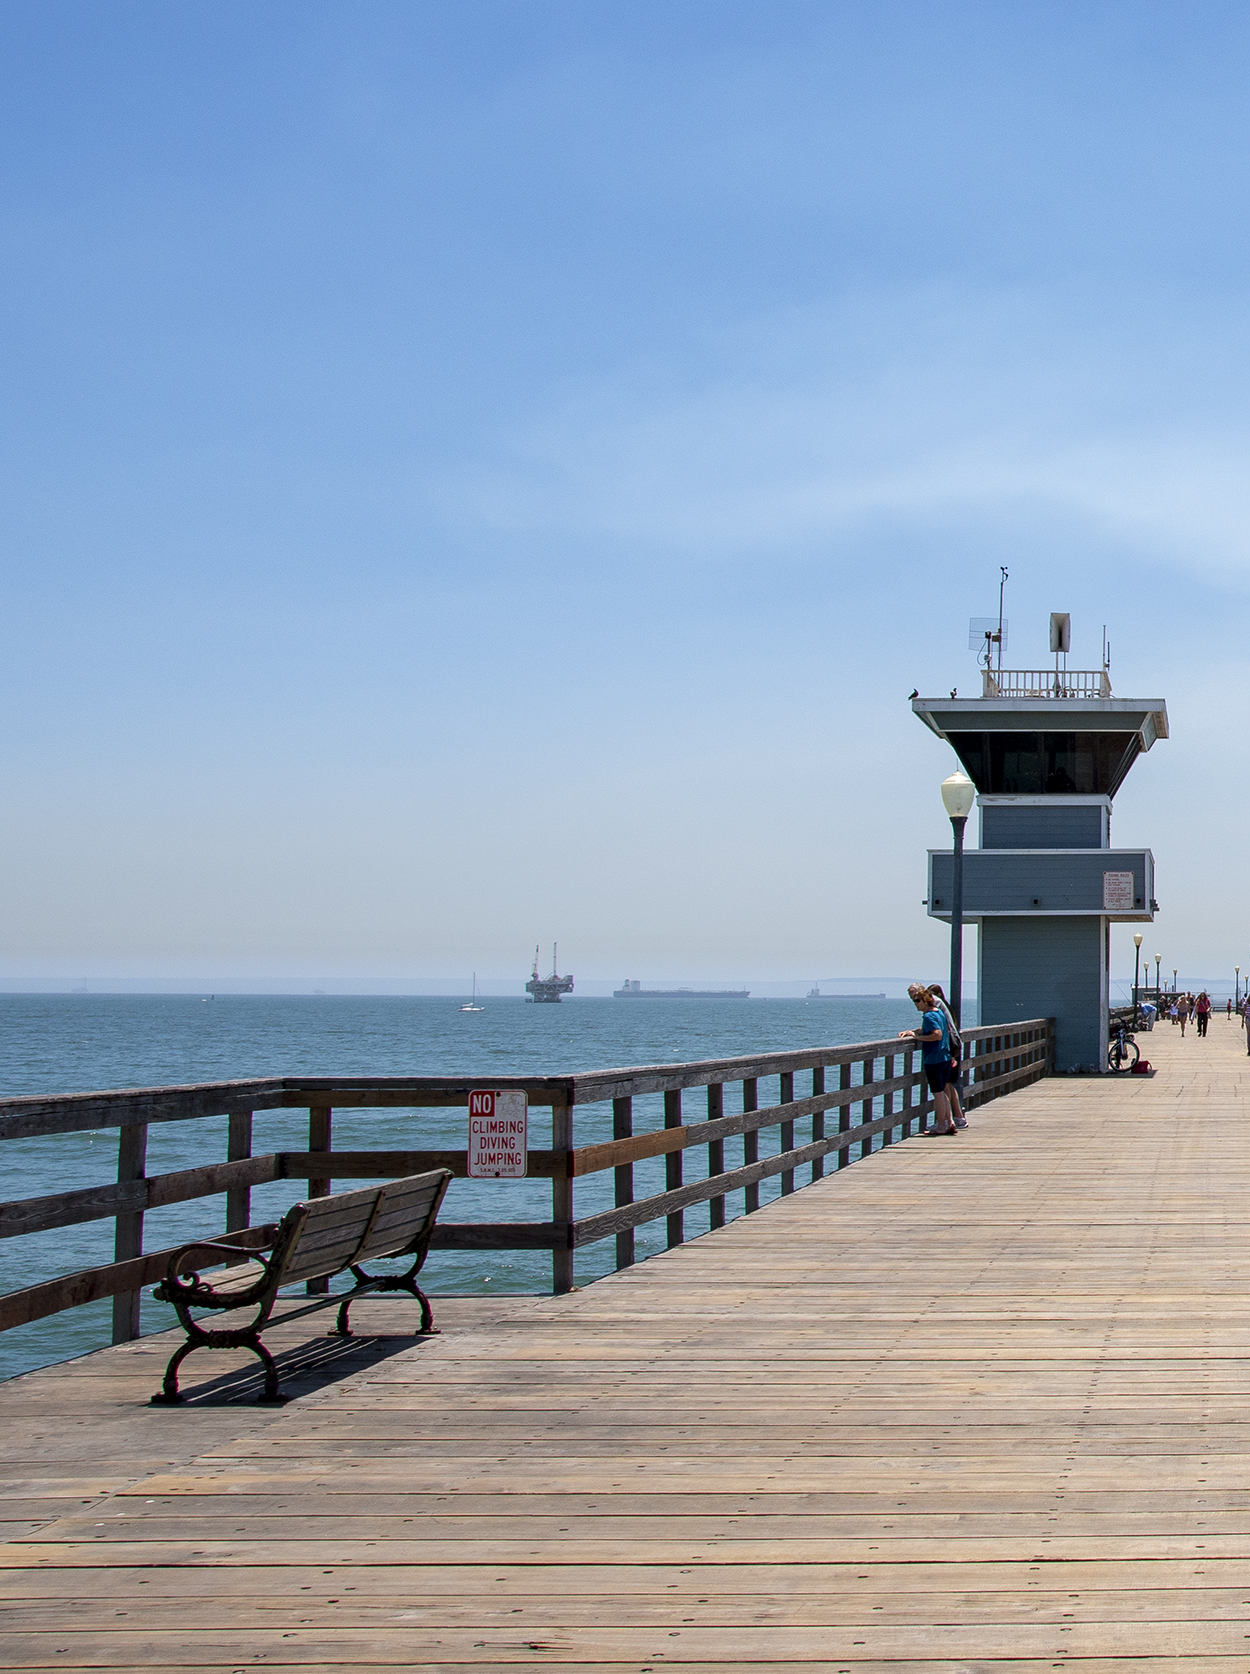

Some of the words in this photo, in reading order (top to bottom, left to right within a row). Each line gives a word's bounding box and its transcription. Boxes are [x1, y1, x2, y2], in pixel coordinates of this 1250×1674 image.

[473, 1094, 492, 1114] NO
[472, 1120, 524, 1134] CLIMBING
[480, 1136, 516, 1150] DIVING
[474, 1152, 522, 1165] JUMPING
